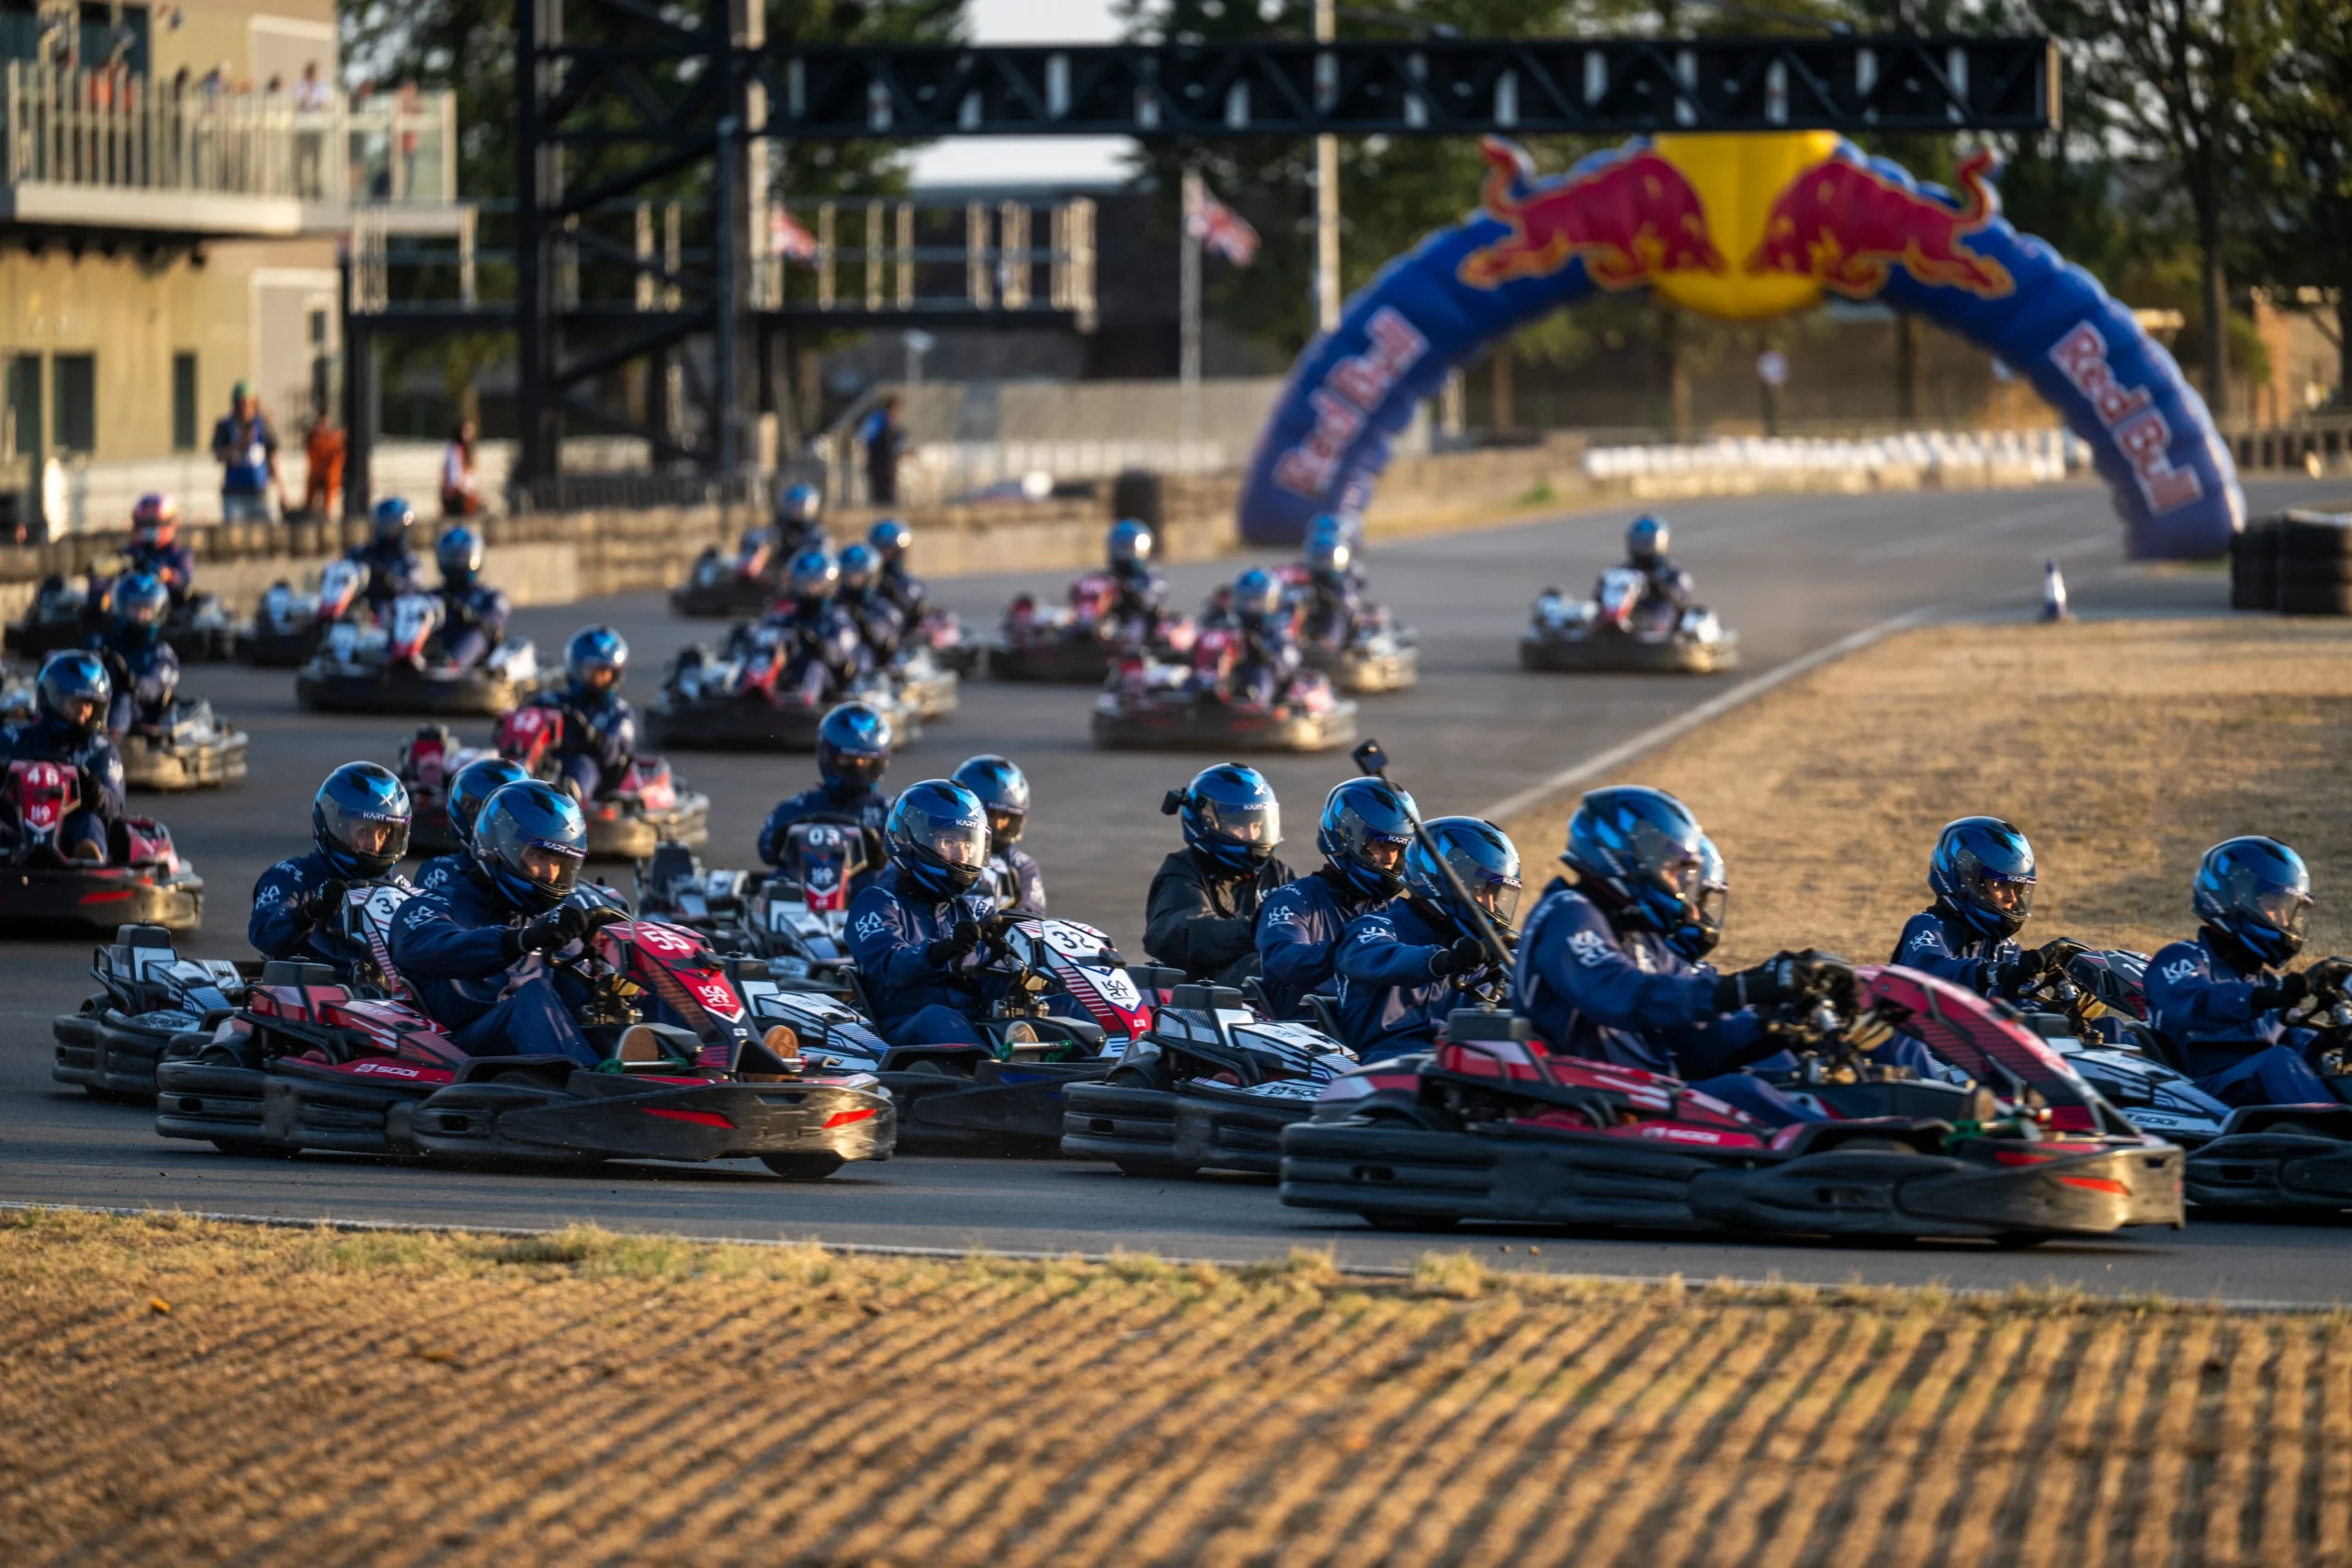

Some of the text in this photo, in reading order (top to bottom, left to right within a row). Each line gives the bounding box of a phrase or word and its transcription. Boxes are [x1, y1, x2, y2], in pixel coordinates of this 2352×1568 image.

[1271, 304, 1430, 500] Red Bull
[2048, 320, 2203, 518] Red Bull
[363, 811, 386, 821] KART
[543, 840, 568, 853] KART
[1387, 835, 1411, 845] KART
[642, 930, 691, 951] 55
[1052, 931, 1096, 950] 32
[374, 1066, 420, 1077] SODI
[2135, 1115, 2178, 1126] SODI
